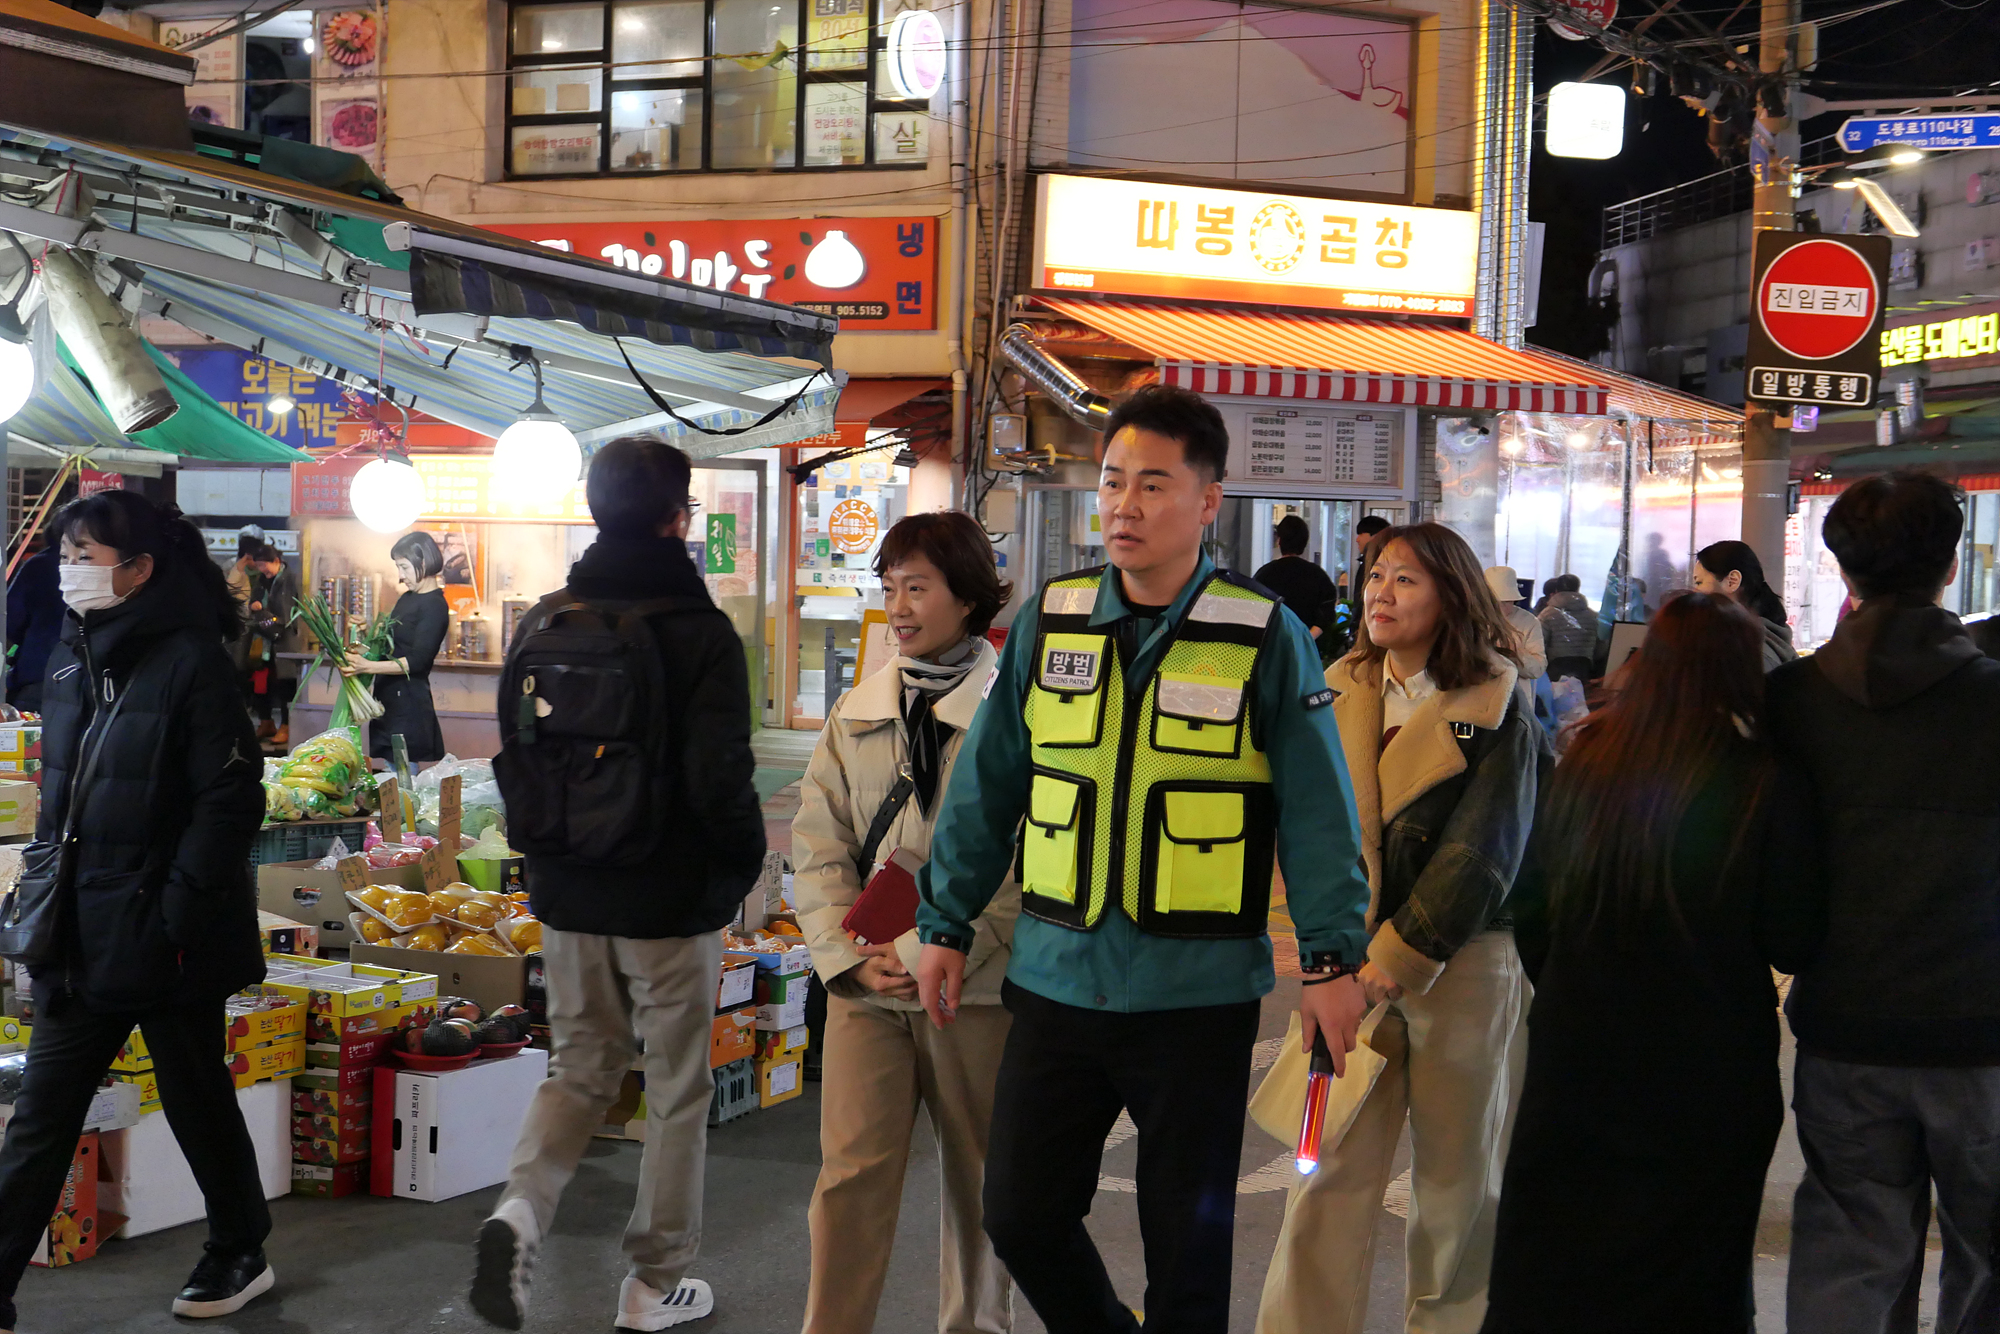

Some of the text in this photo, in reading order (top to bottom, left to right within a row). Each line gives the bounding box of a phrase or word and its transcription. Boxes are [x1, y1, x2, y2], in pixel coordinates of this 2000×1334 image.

[892, 120, 921, 153] 살
[1847, 131, 1862, 141] 32
[1876, 118, 1974, 137] 도봉로110나길
[1136, 199, 1413, 269] 따봉 곱창
[896, 223, 924, 316] 냉면
[836, 305, 883, 316] 905.5152
[1774, 286, 1863, 313] 진입금지
[1924, 312, 1999, 361] 도매센터
[242, 358, 317, 395] 오늘은
[1761, 371, 1859, 401] 일방통행
[832, 500, 876, 519] HACCP
[1052, 653, 1091, 676] 방범
[1044, 675, 1091, 687] CITIZENS PATROL
[260, 1012, 296, 1032] 논산 딸기
[260, 1048, 296, 1069] 논산 딸기
